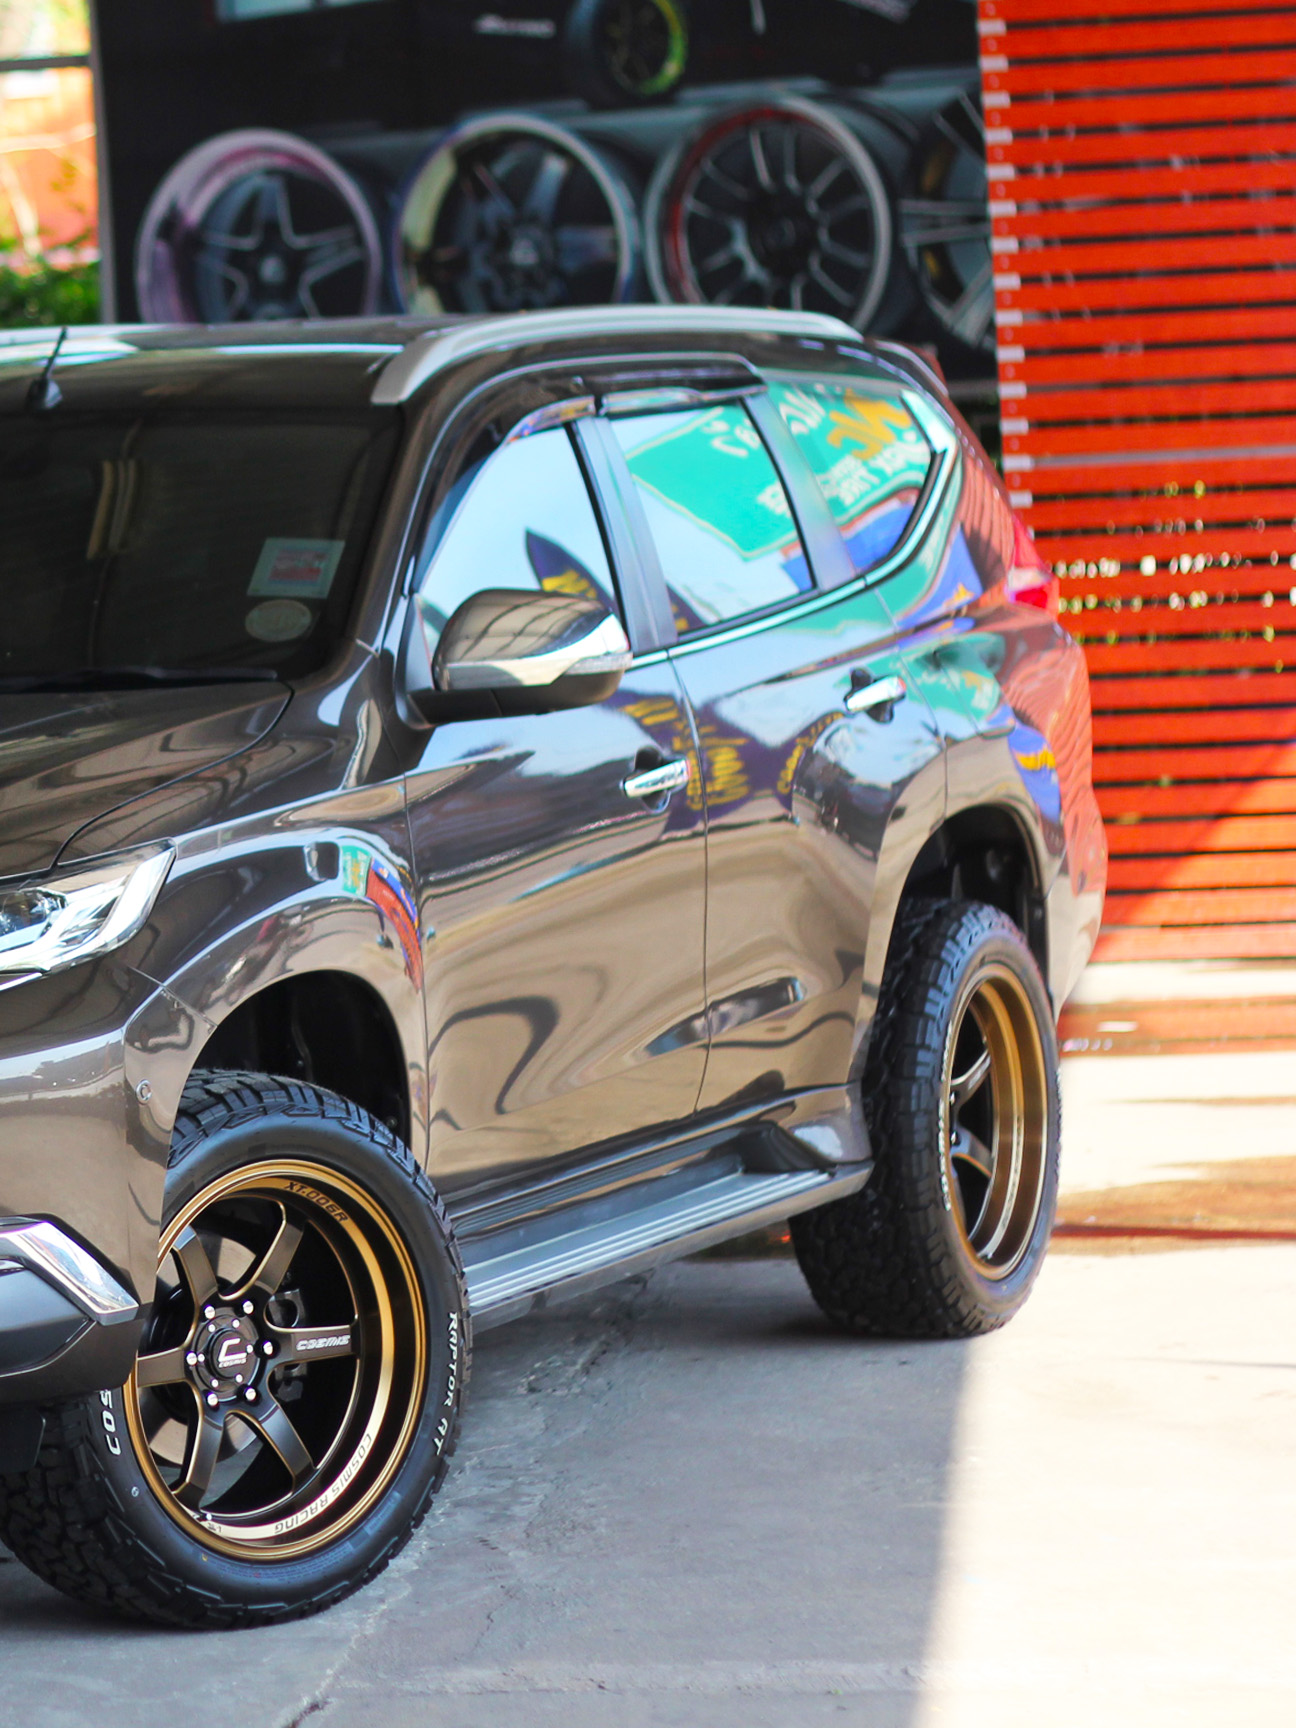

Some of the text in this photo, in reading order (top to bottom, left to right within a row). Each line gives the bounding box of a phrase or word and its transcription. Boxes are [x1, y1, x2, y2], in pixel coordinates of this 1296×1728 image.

[284, 1181, 349, 1222] XT.006R
[296, 1335, 351, 1351] COSMIS
[433, 1311, 459, 1456] RAPTOR AT
[274, 1432, 372, 1534] COSMIS RACING
